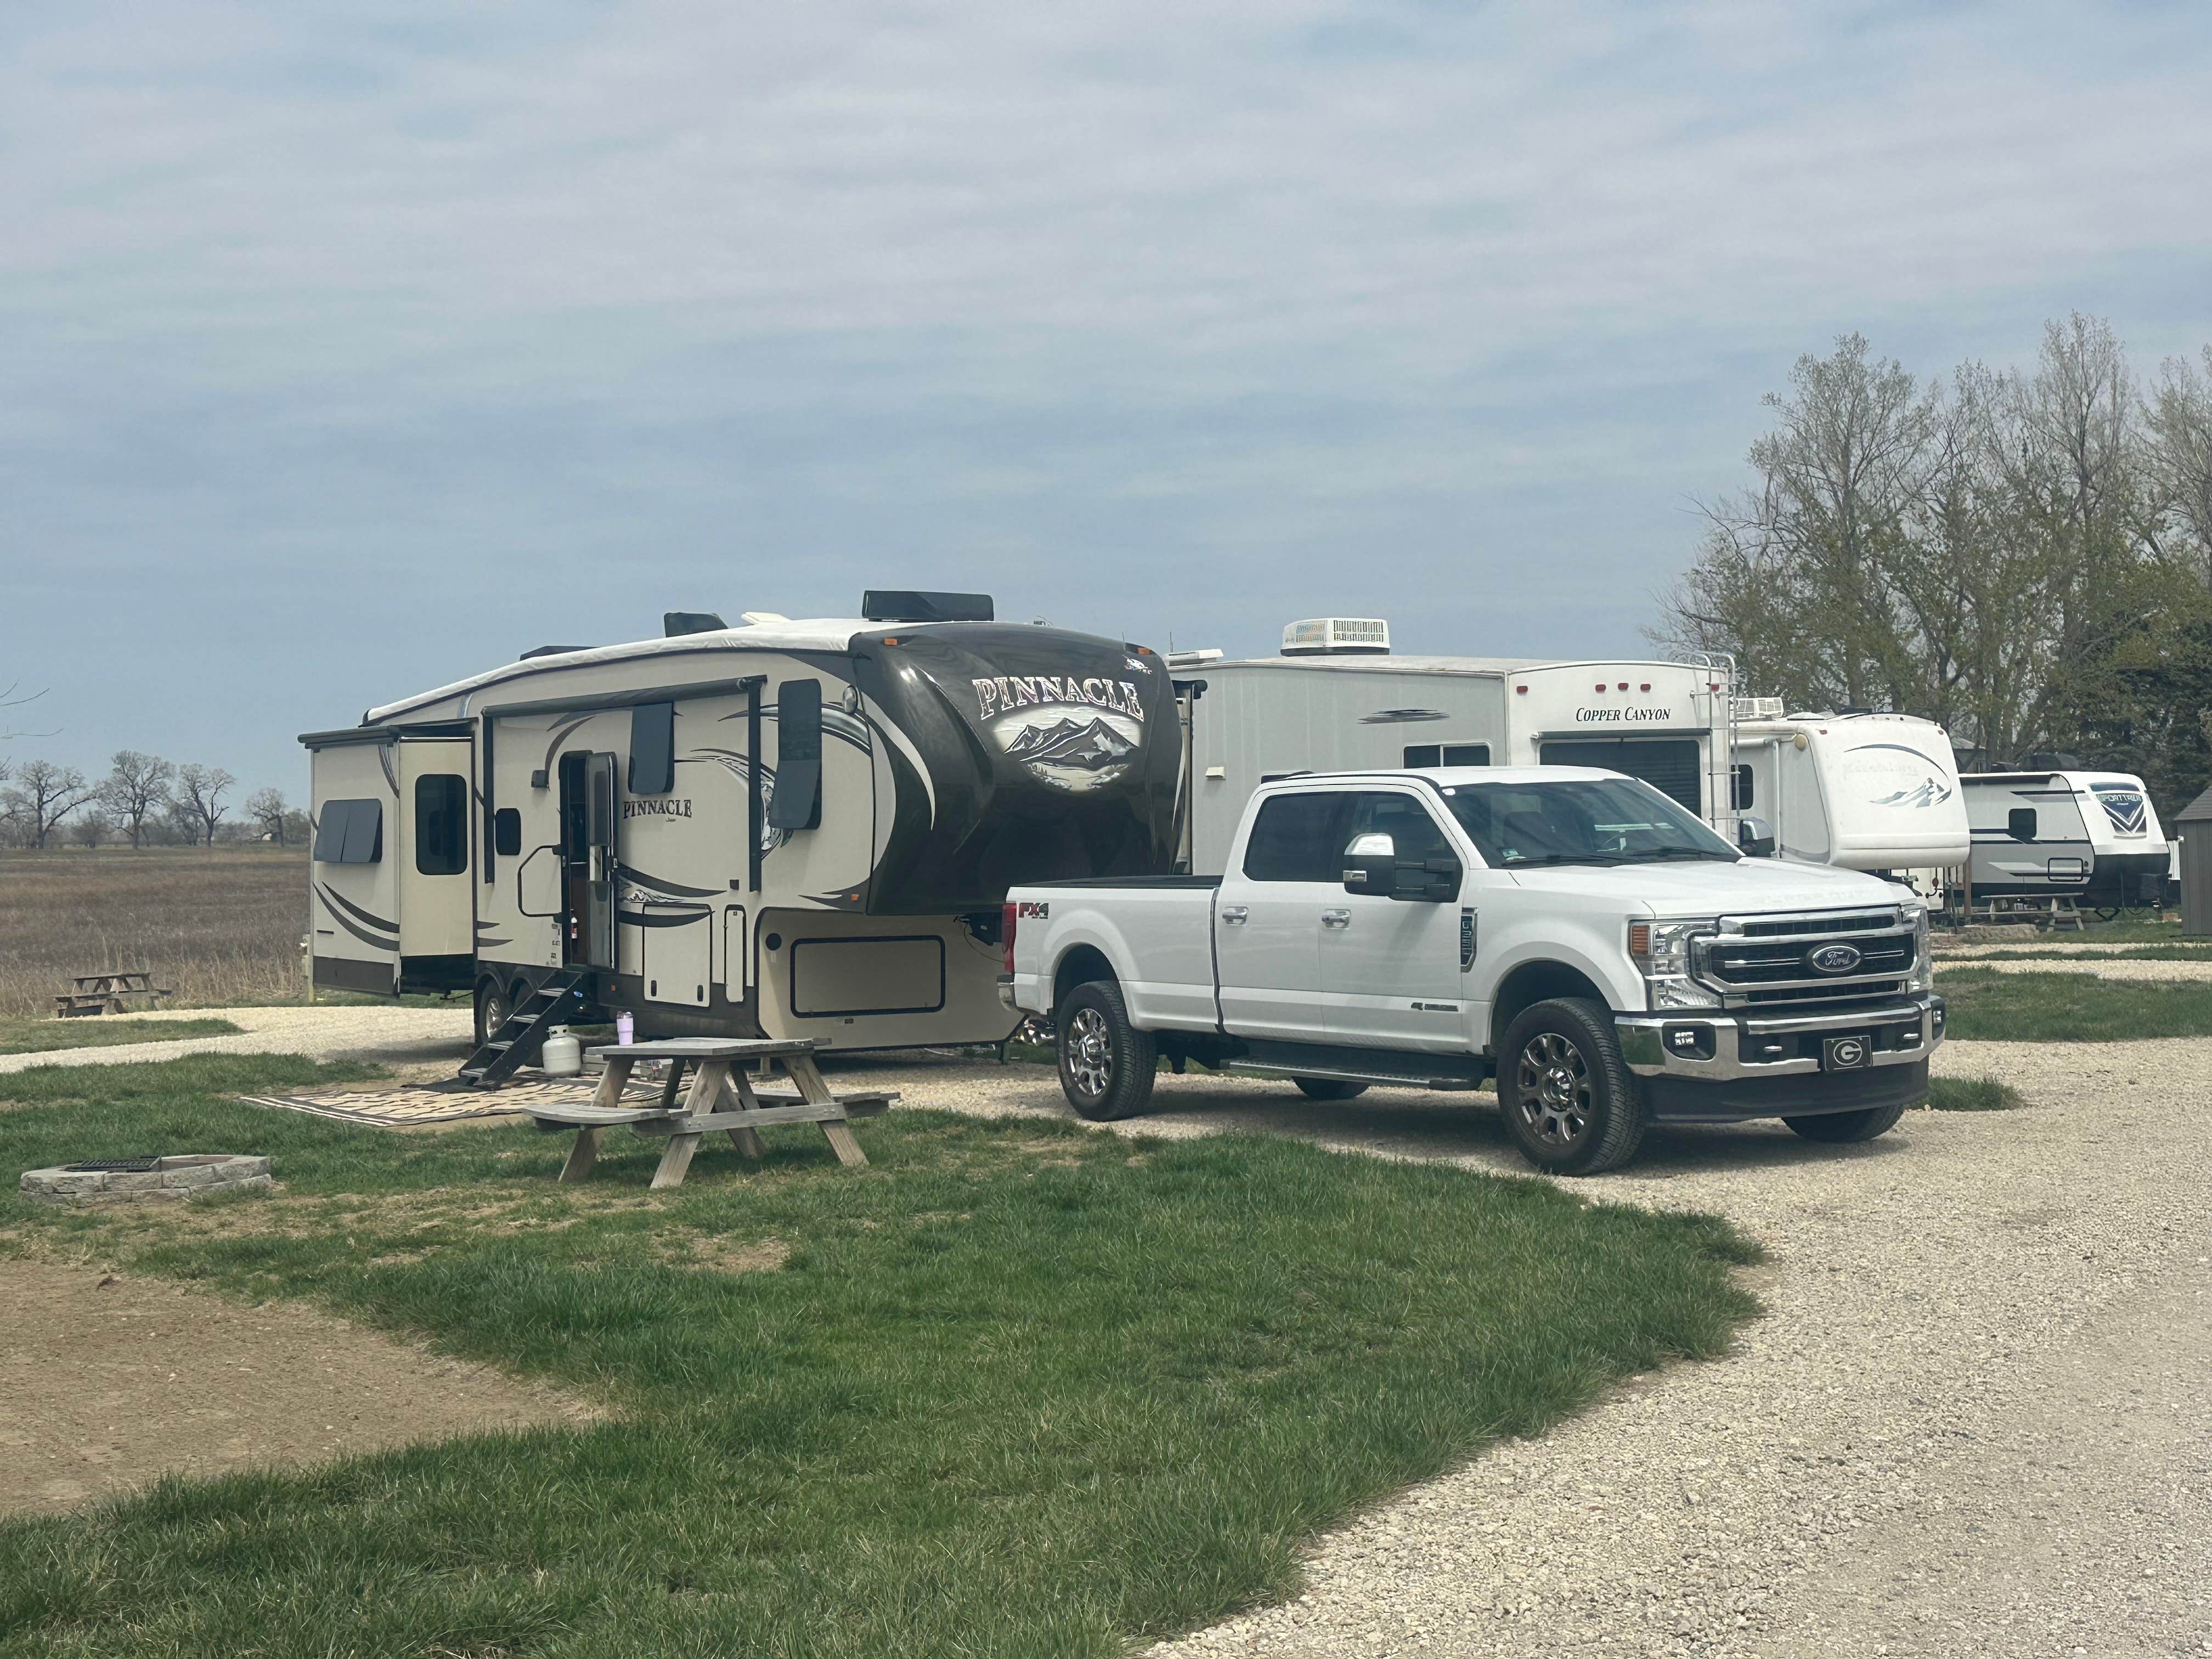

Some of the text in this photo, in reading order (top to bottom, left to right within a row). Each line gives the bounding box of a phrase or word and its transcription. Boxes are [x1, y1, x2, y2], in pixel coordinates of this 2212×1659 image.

[972, 676, 1144, 723] PINNACLE
[1576, 707, 1671, 721] COPPER CANYON
[623, 799, 692, 819] PINNACLE
[1019, 902, 1049, 918] FX4
[1825, 951, 1852, 966] Ford
